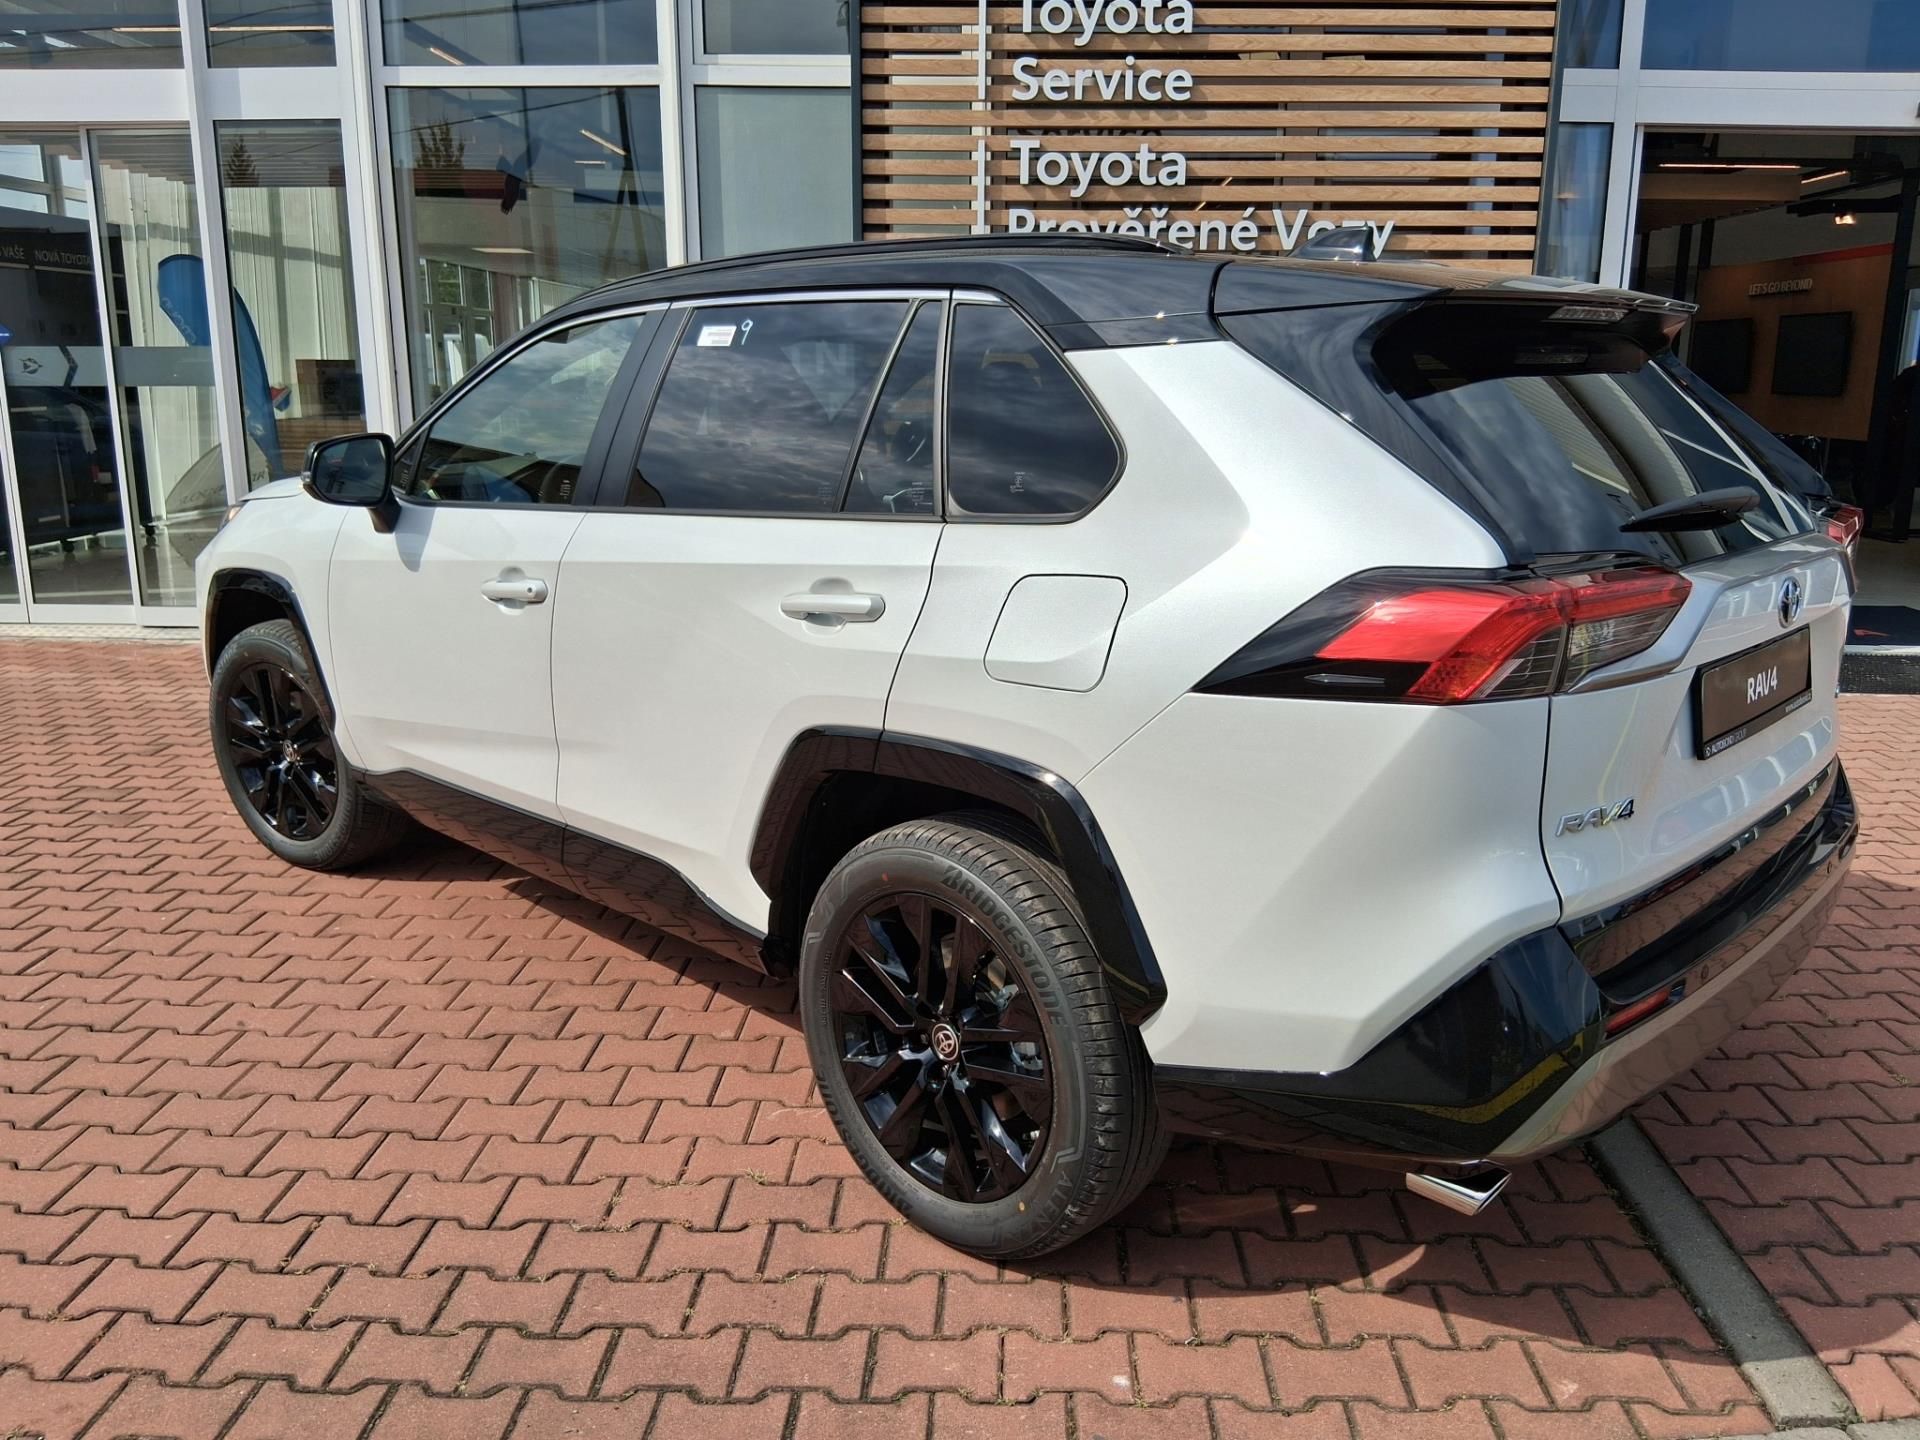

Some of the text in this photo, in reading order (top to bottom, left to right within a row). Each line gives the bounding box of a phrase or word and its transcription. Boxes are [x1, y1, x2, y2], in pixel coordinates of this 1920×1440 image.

[1011, 55, 1194, 101] Service
[1009, 139, 1187, 198] Toyota
[1768, 281, 1780, 293] GO
[741, 319, 753, 345] 9
[1747, 666, 1778, 704] RAV4
[1555, 798, 1635, 837] RAV4
[941, 864, 1069, 1025] BRIDGESTONE
